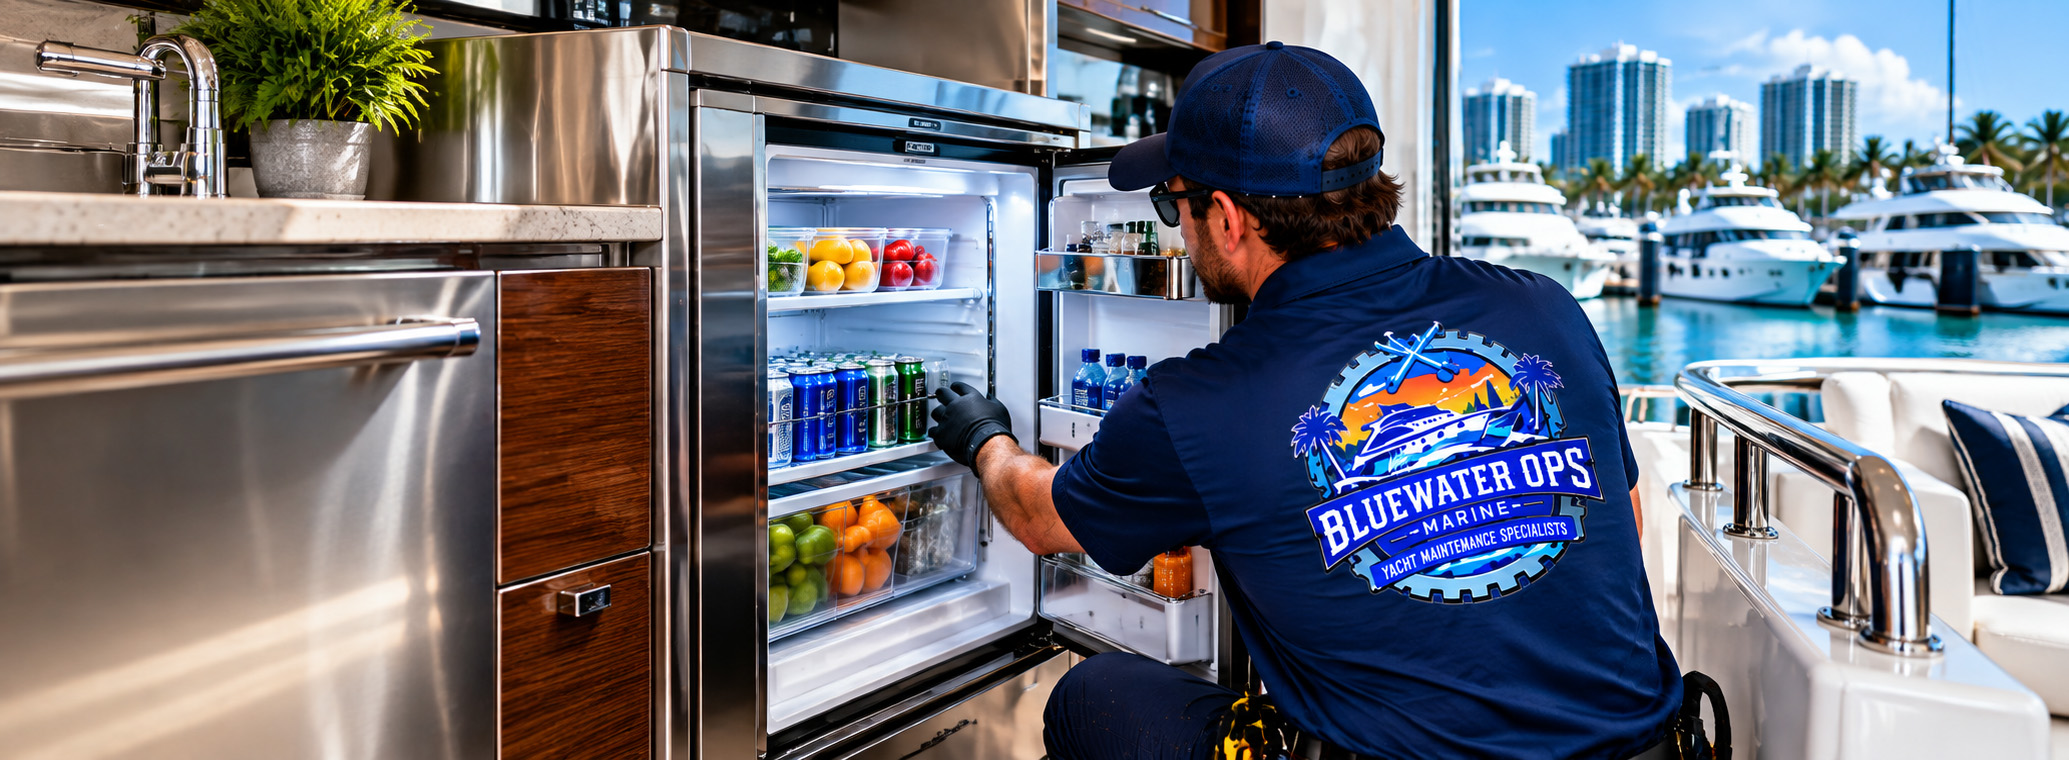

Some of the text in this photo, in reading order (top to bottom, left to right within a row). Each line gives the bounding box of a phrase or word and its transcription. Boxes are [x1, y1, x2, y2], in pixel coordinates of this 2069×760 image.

[1318, 446, 1592, 557] BLUEWATER OPS
[1381, 553, 1417, 580] YACHT
[1501, 521, 1568, 543] SPECIALISTS
